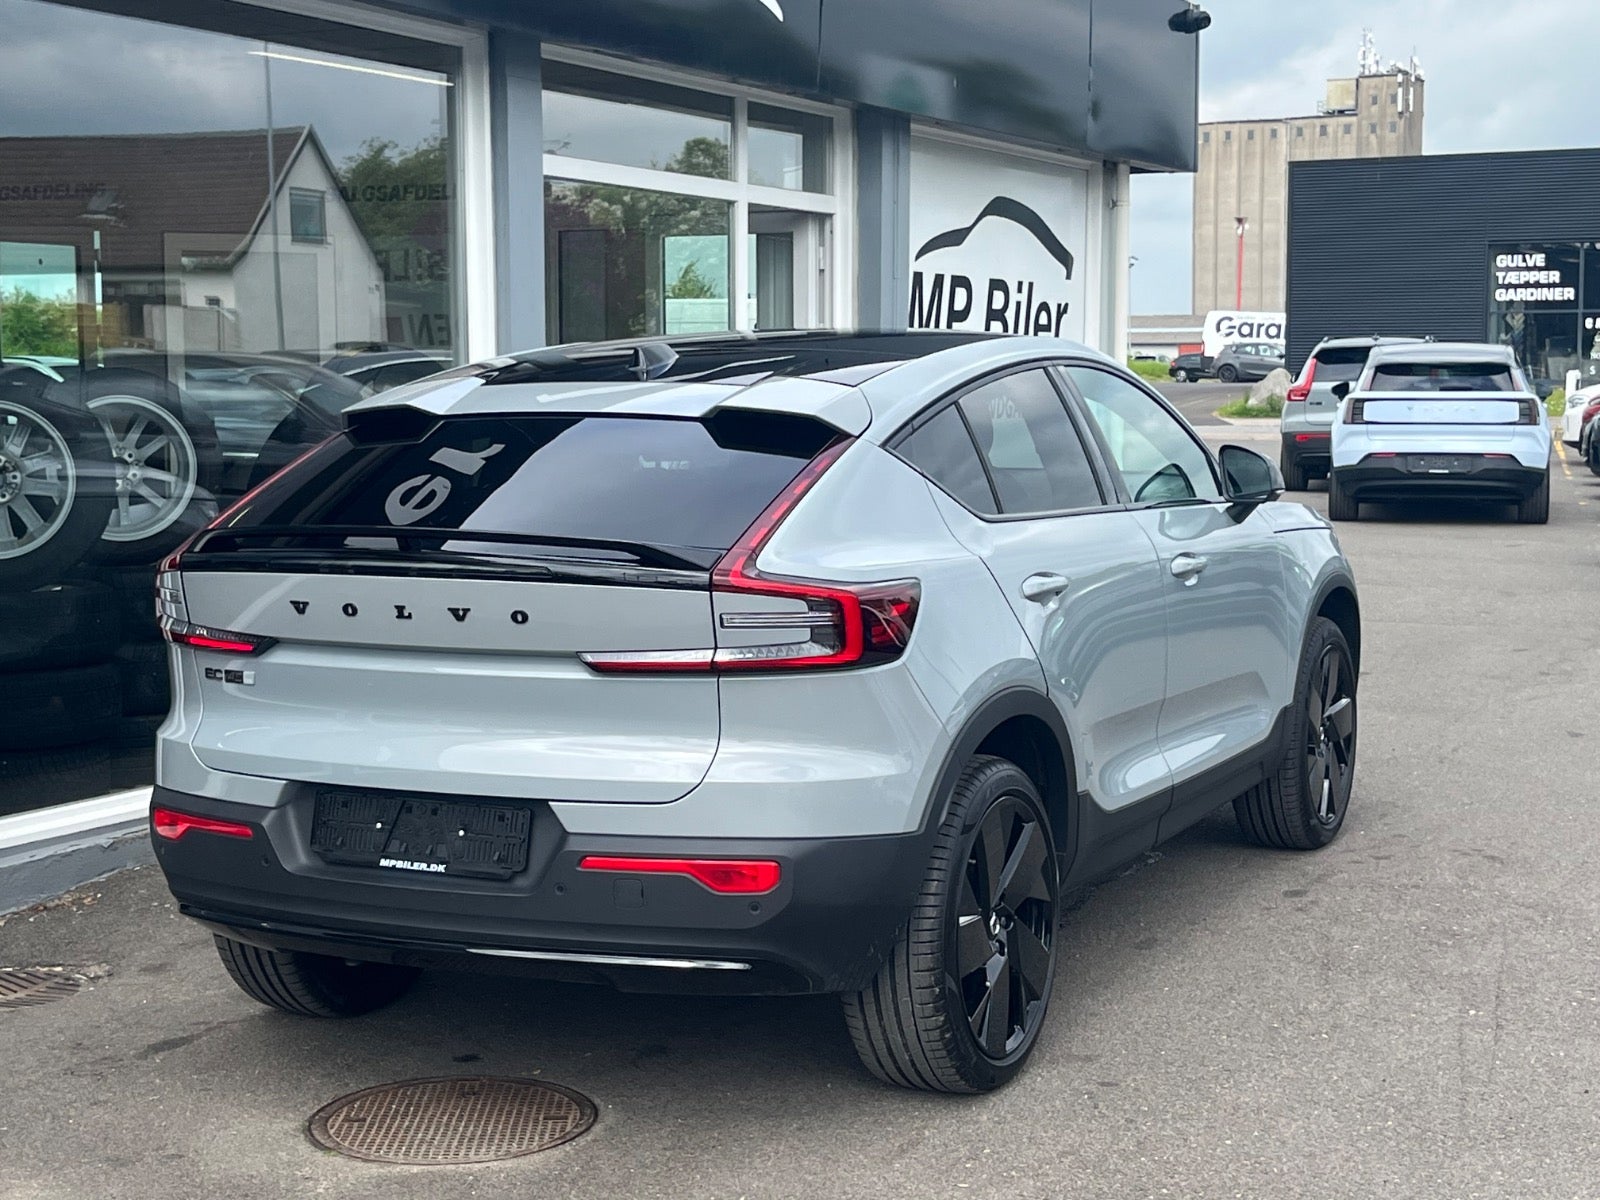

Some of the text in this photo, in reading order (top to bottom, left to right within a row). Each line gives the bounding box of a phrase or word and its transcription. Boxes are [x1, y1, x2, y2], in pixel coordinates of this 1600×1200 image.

[1496, 254, 1546, 268] GULVE
[1496, 270, 1561, 285] TÆPPER
[1495, 287, 1575, 302] GARDINER
[908, 271, 1069, 338] MP Biler
[289, 600, 530, 624] VOLVO
[379, 858, 447, 873] MPBILER.DK
